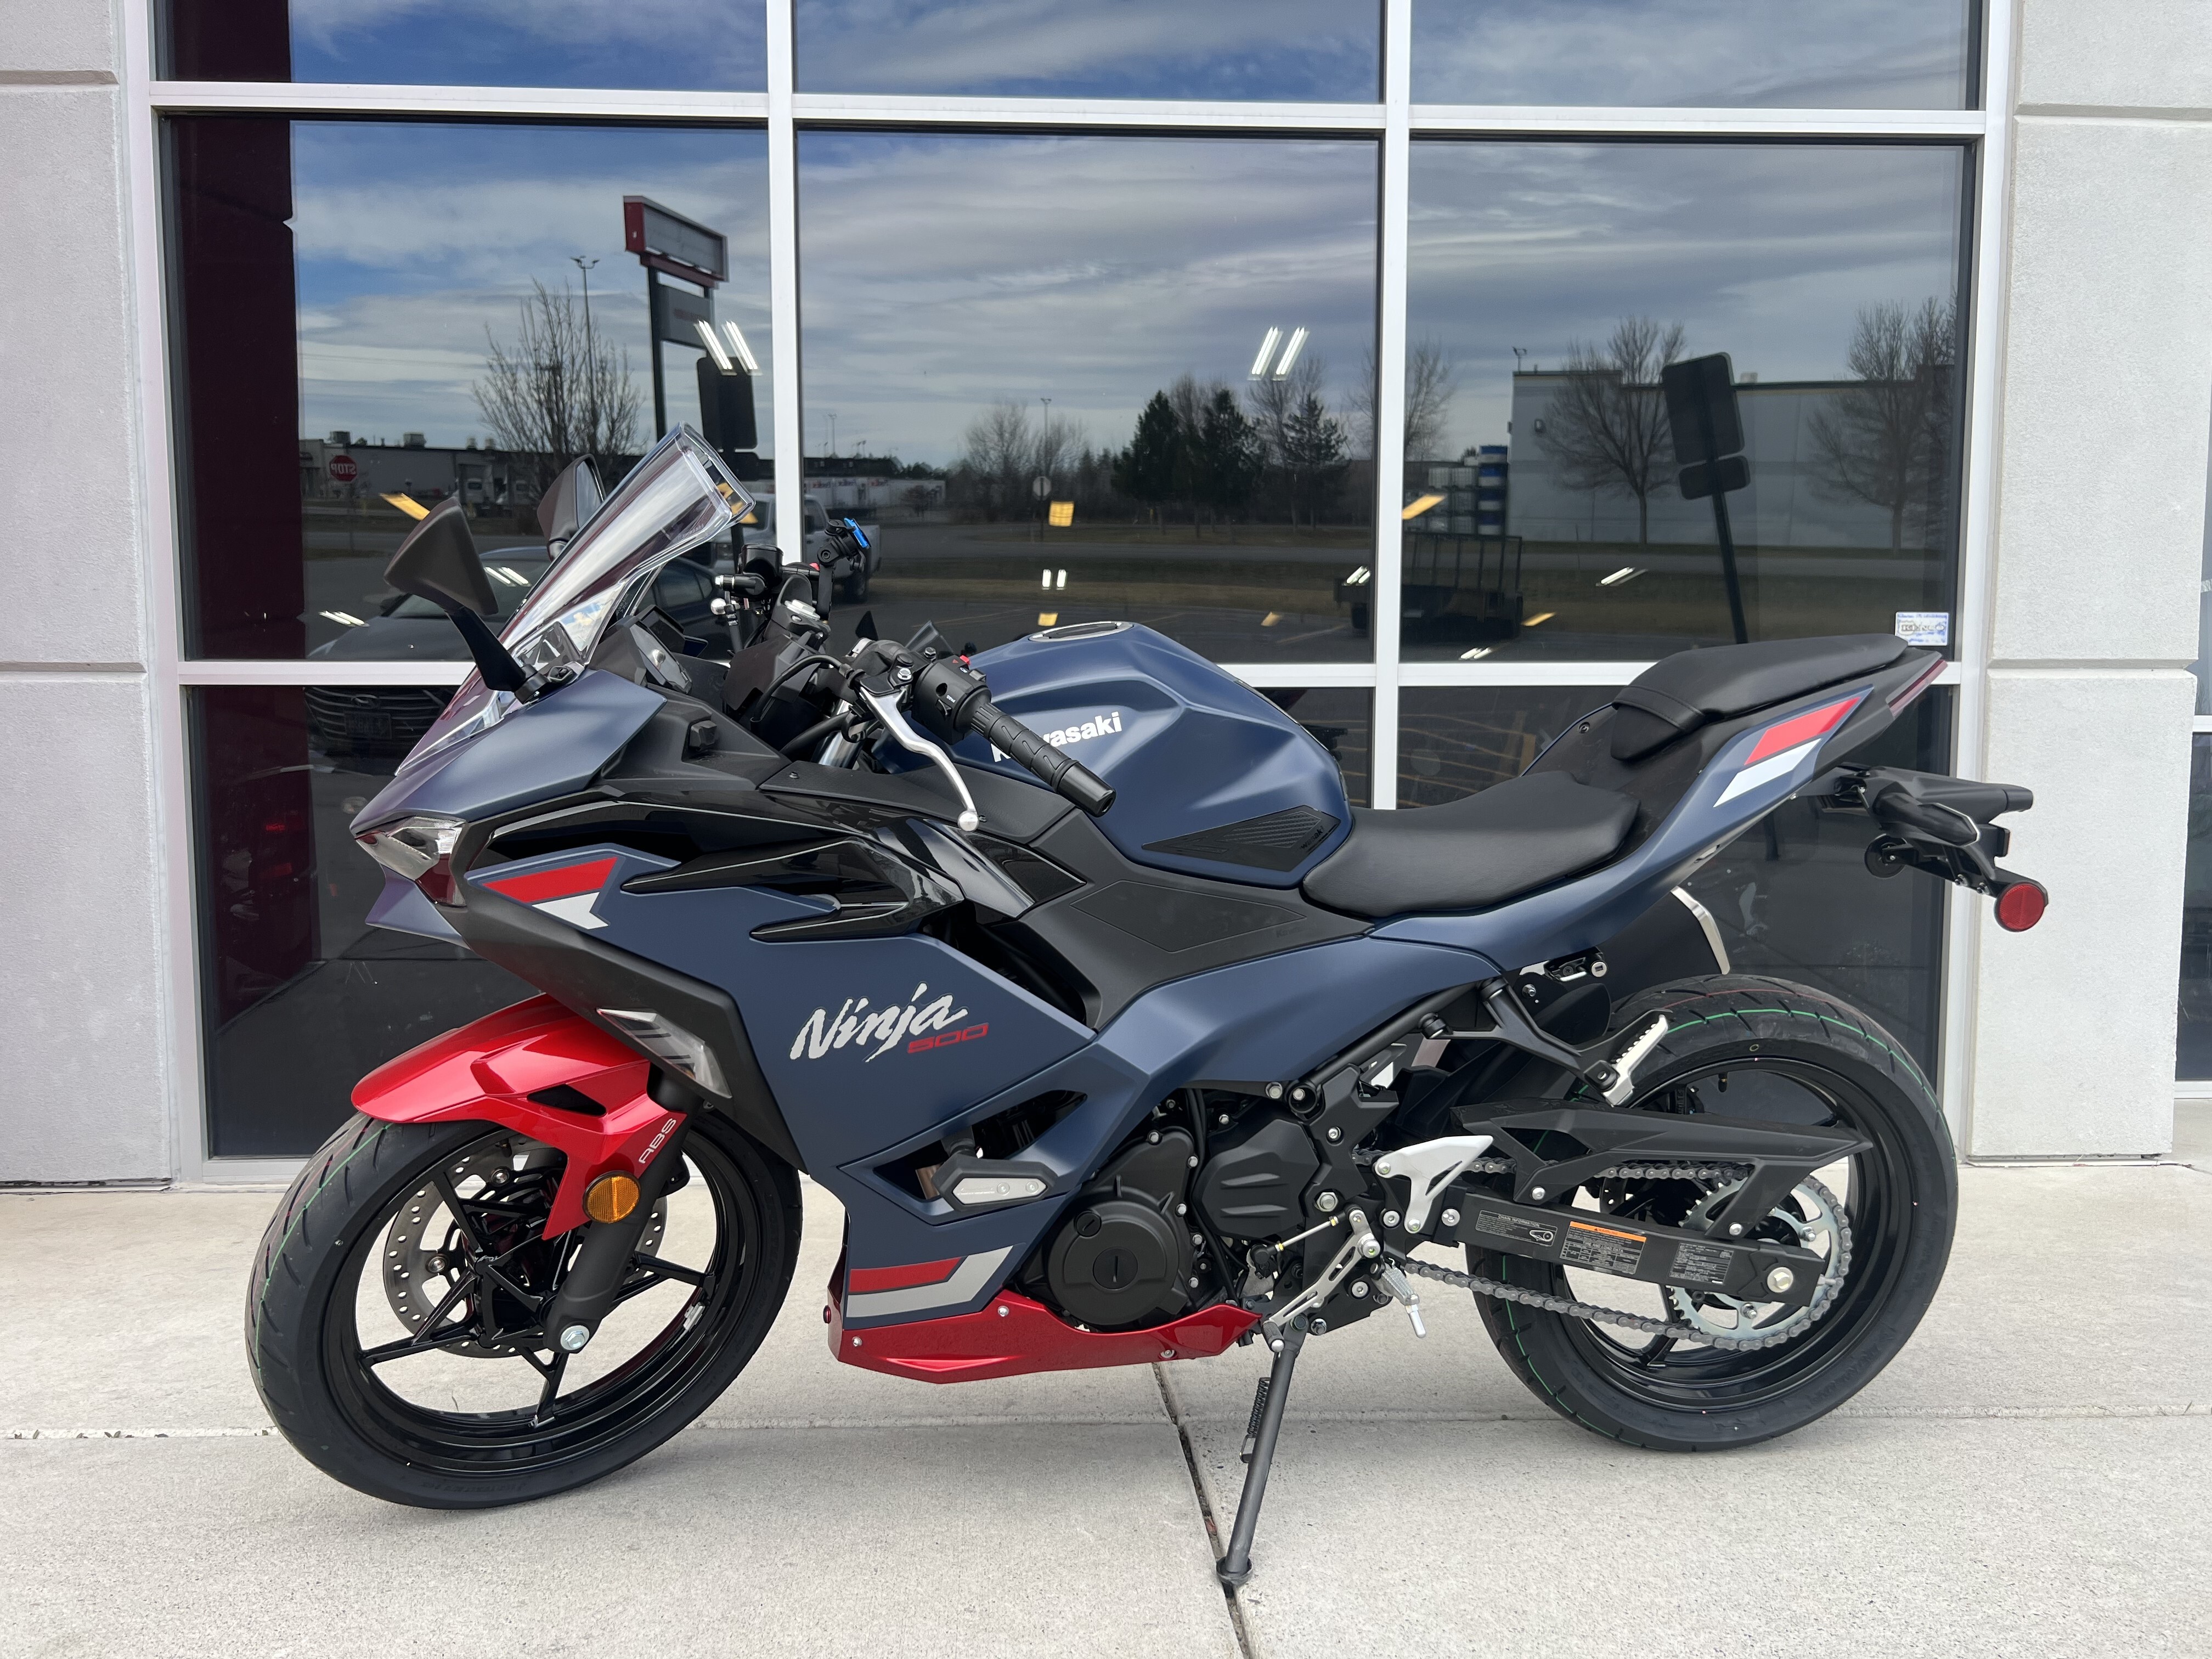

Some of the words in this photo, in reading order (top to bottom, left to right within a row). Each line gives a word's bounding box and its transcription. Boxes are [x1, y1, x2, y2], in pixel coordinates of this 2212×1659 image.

[790, 982, 969, 1063] Ninja
[907, 1023, 989, 1053] 500
[639, 1118, 676, 1164] ABS
